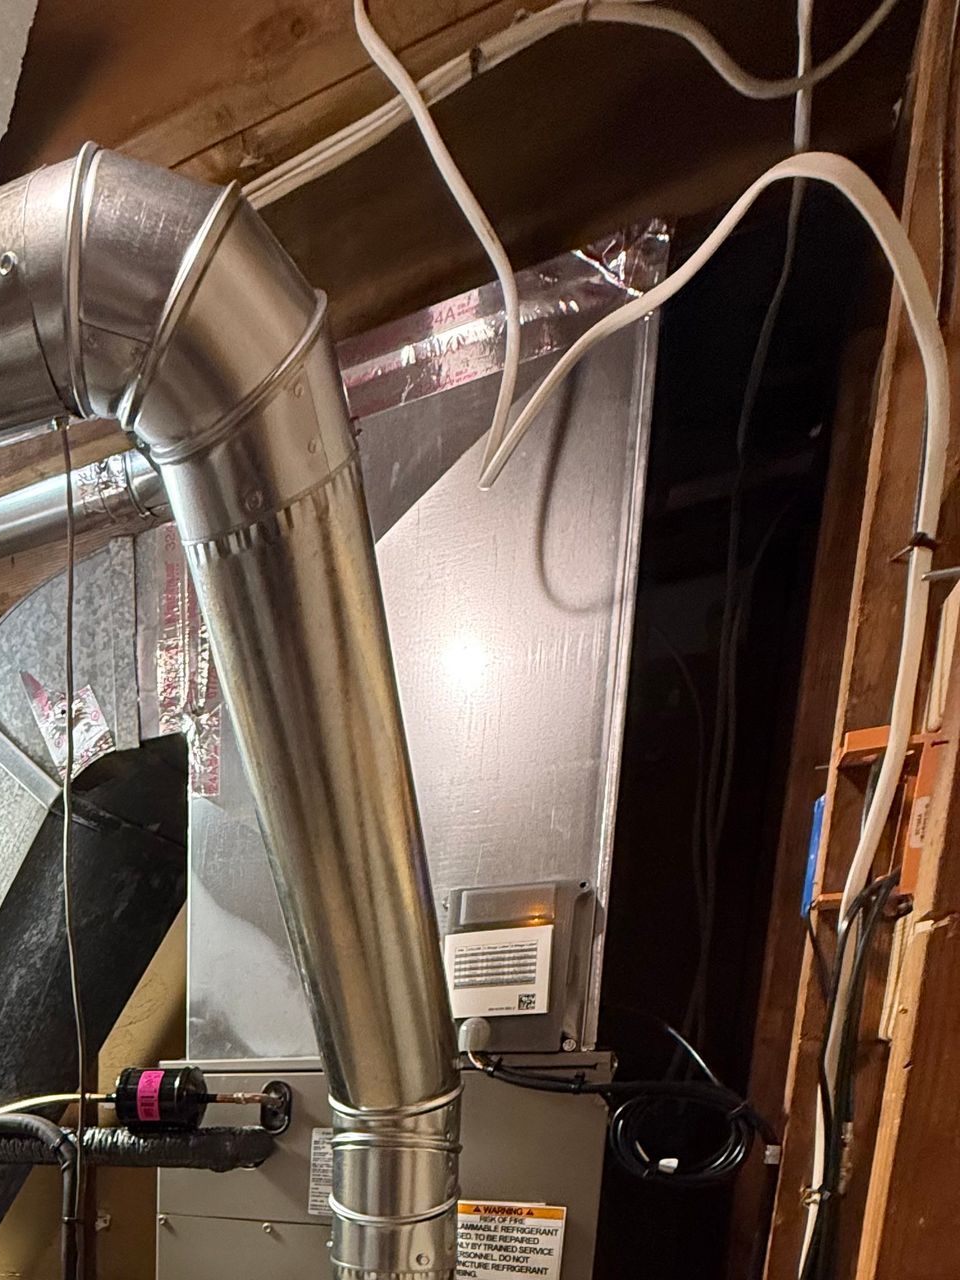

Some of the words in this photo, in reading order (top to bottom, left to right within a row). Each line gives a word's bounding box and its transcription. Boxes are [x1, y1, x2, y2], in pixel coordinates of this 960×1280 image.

[483, 1206, 523, 1216] WARNING
[480, 1216, 496, 1224] RISK
[501, 1225, 559, 1237] REFRIGERANT
[475, 1233, 485, 1242] TO
[487, 1234, 498, 1243] BE
[499, 1235, 539, 1245] REPAIRED
[471, 1243, 482, 1251] BY
[483, 1243, 517, 1253] TRAINED
[518, 1246, 554, 1256] SERVICE
[499, 1254, 511, 1262] DO
[512, 1255, 530, 1264] NOT
[491, 1263, 549, 1276] REFRIGERANT
